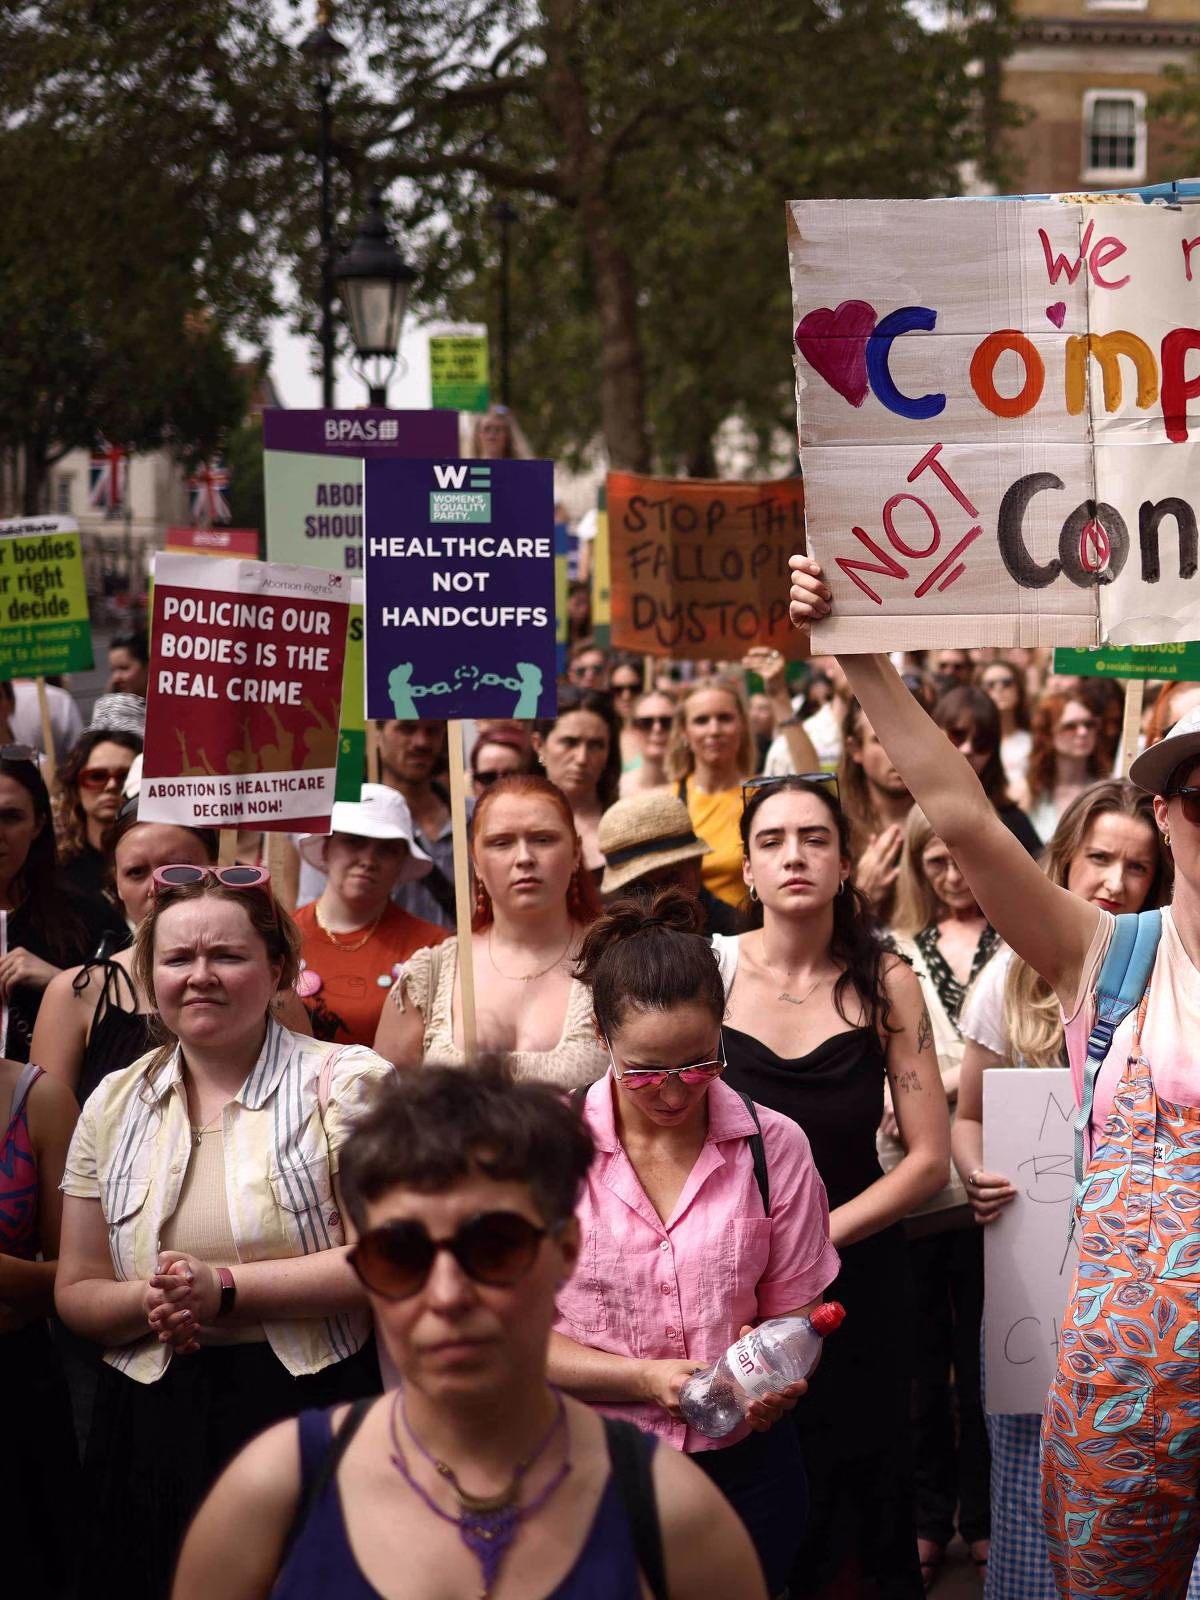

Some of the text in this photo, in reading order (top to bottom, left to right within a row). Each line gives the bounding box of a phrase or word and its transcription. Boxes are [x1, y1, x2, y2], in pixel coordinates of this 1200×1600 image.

[1039, 219, 1128, 289] We
[324, 419, 378, 441] BPAS
[433, 494, 484, 504] WOMEN'S
[433, 503, 486, 512] EQUALITY
[623, 495, 725, 536] STOP
[836, 443, 979, 604] NOT
[12, 536, 76, 564] bodies
[370, 537, 551, 558] HEALTHCARE
[18, 565, 64, 598] right
[262, 578, 333, 595] Abortion Rights
[432, 572, 490, 592] NOT
[8, 593, 70, 620] decide
[163, 597, 274, 630] POLICING
[281, 608, 330, 635] OUR
[382, 606, 548, 627] HANDCUFFS
[160, 633, 330, 671] BODIES IS THE
[158, 671, 302, 705] REAL CRIME
[148, 776, 325, 798] ABORTION IS HEALTHCARE
[193, 800, 282, 817] DECRIM NOW!
